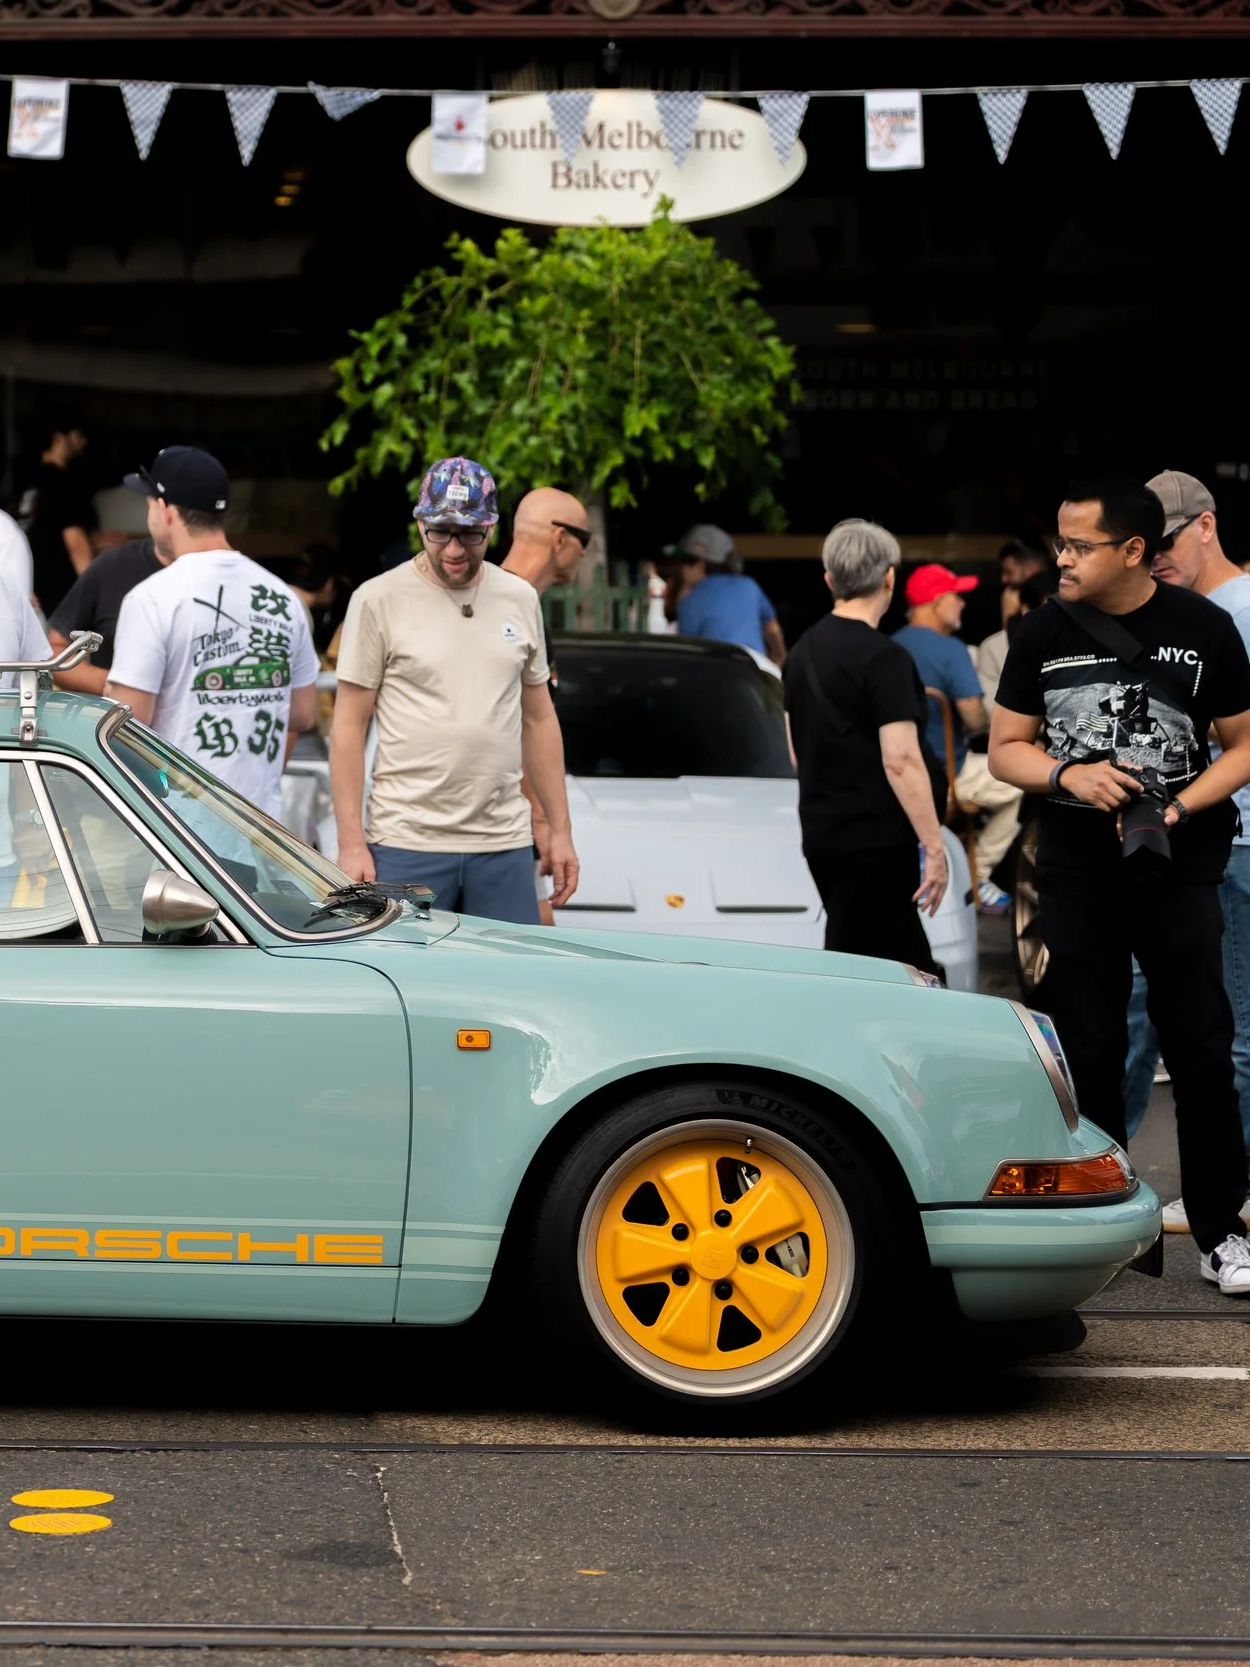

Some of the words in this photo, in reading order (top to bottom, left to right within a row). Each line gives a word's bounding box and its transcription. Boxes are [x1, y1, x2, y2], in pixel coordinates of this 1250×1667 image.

[485, 121, 558, 150] outh
[581, 121, 746, 150] Melborne
[551, 160, 661, 199] Bakery
[884, 388, 941, 411] AND
[250, 584, 292, 621] 改
[193, 641, 241, 667] Custom
[194, 627, 234, 650] Tokyo
[248, 625, 292, 662] 造
[247, 709, 285, 764] 35
